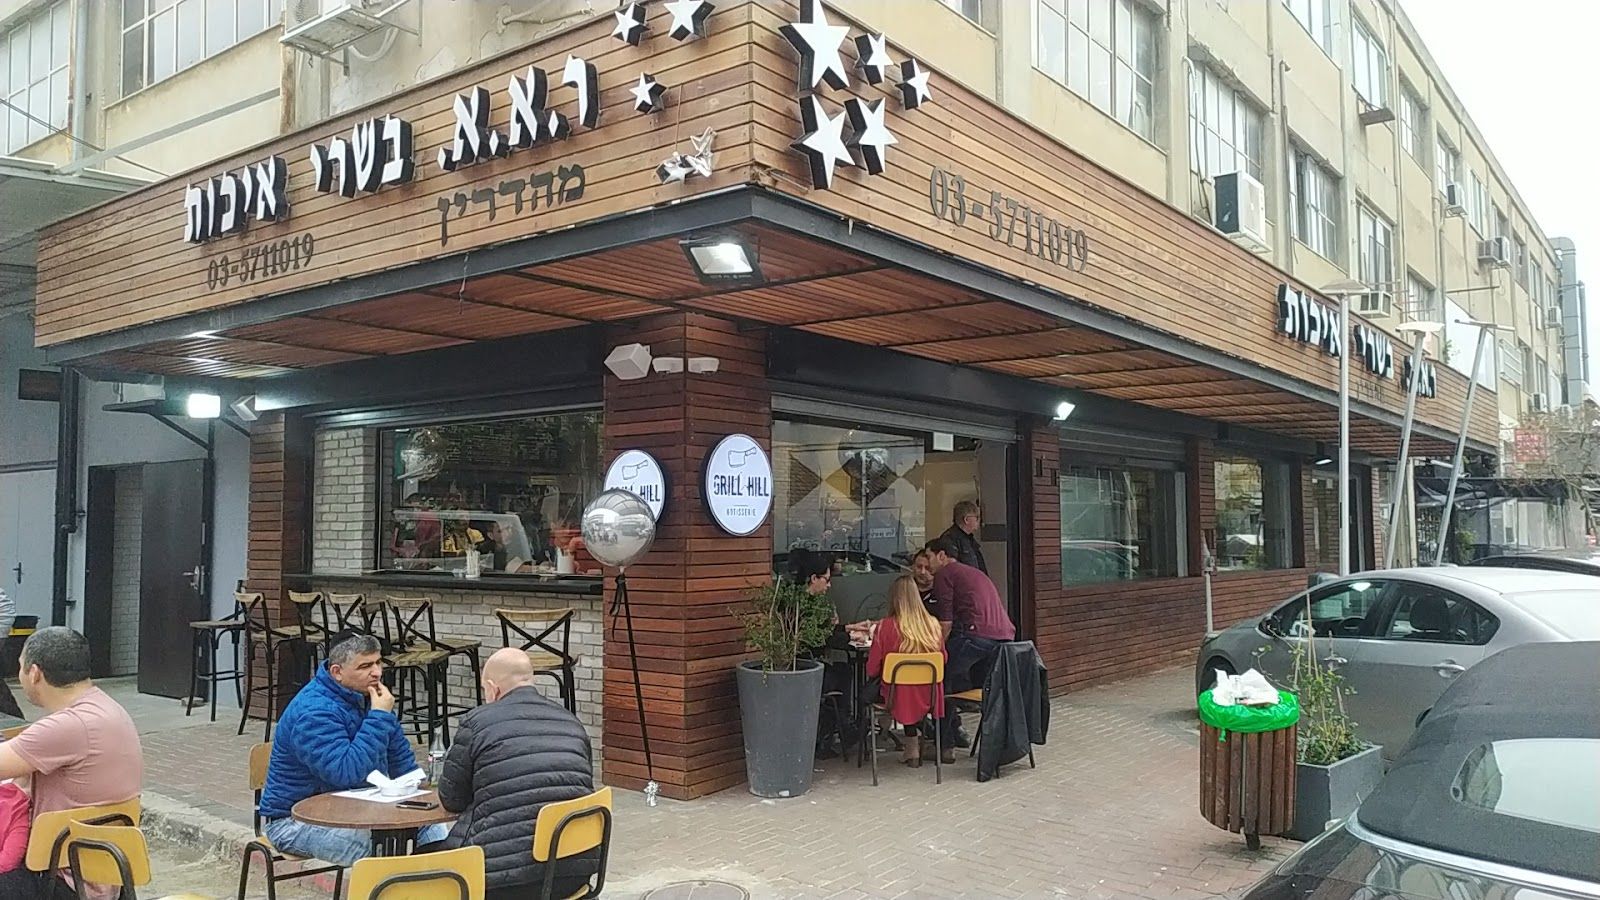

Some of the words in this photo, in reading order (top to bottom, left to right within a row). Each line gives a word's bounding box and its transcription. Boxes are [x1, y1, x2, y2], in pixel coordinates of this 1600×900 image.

[310, 113, 411, 199] בשרי
[184, 154, 287, 244] איכות
[437, 163, 586, 248] מהדרין
[929, 165, 1089, 275] 03-5711019
[207, 232, 315, 291] 03-5711019
[1279, 282, 1342, 358] איכות
[1356, 324, 1395, 380] בשרי
[639, 484, 661, 502] HILL
[713, 473, 744, 497] GRILL
[747, 475, 770, 498] HILL
